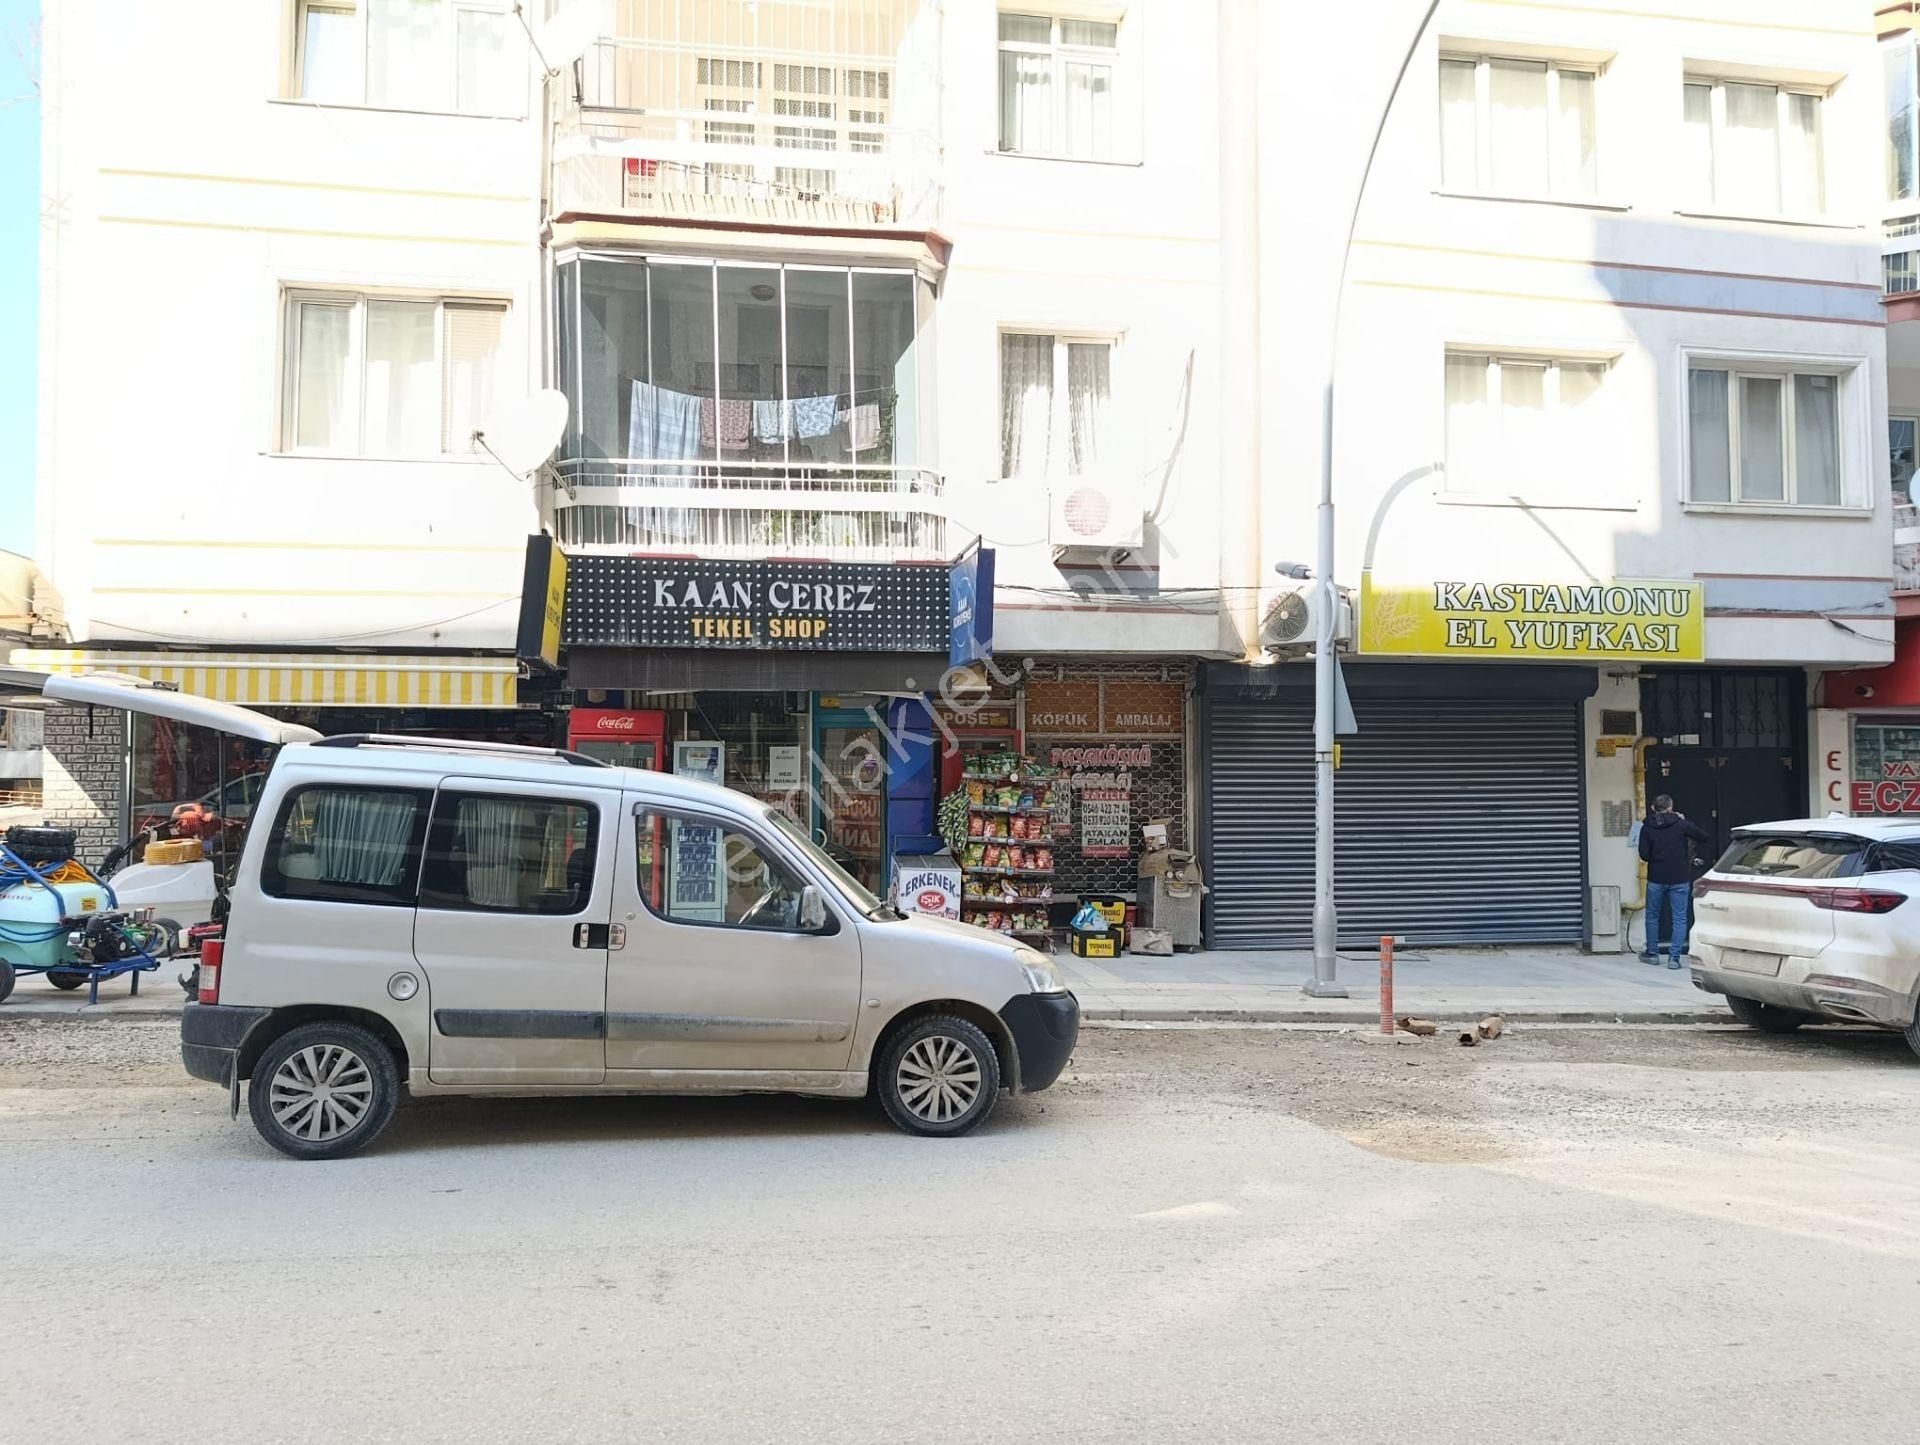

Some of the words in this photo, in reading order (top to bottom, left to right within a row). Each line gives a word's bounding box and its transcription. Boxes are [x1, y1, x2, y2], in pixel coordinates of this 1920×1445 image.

[653, 579, 753, 610] KAAN
[768, 581, 876, 614] ÇEREZ
[1434, 581, 1691, 617] KASTAMONU
[691, 618, 753, 638] TEKEL
[769, 618, 826, 639] SHOP
[1446, 618, 1496, 648] EL
[1505, 620, 1680, 652] YUFKASI
[1032, 711, 1089, 726] KÖPÜK
[1115, 713, 1172, 727] AMBALAJ
[1083, 790, 1128, 800] SATILIK
[1088, 838, 1124, 846] EMLAK
[905, 872, 957, 898] ERKENEK
